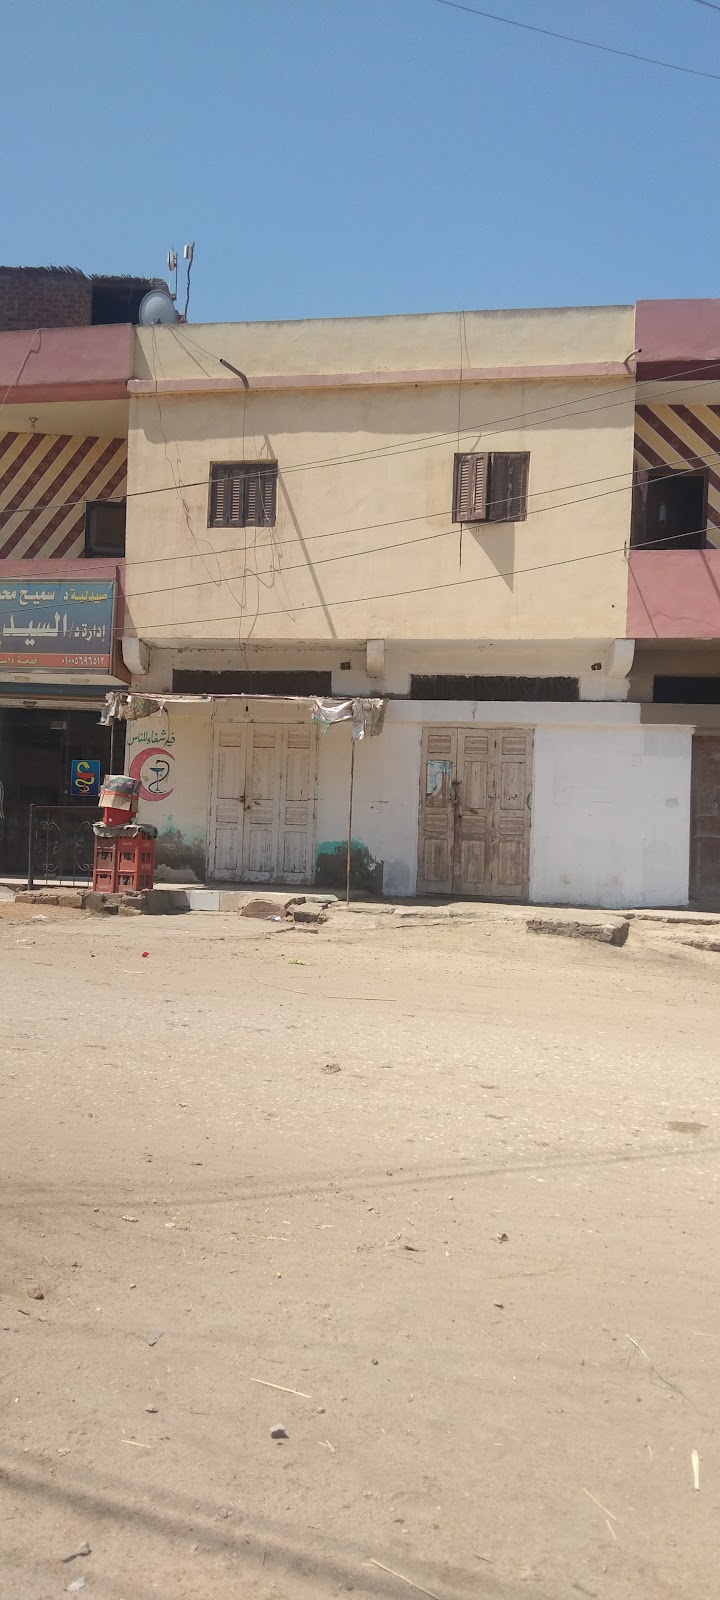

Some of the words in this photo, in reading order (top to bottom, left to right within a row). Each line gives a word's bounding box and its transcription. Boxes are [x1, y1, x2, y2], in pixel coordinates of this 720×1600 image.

[20, 589, 55, 606] سميح
[70, 588, 108, 604] صيدلية
[2, 611, 68, 646] السيد
[82, 623, 106, 642] إدارة
